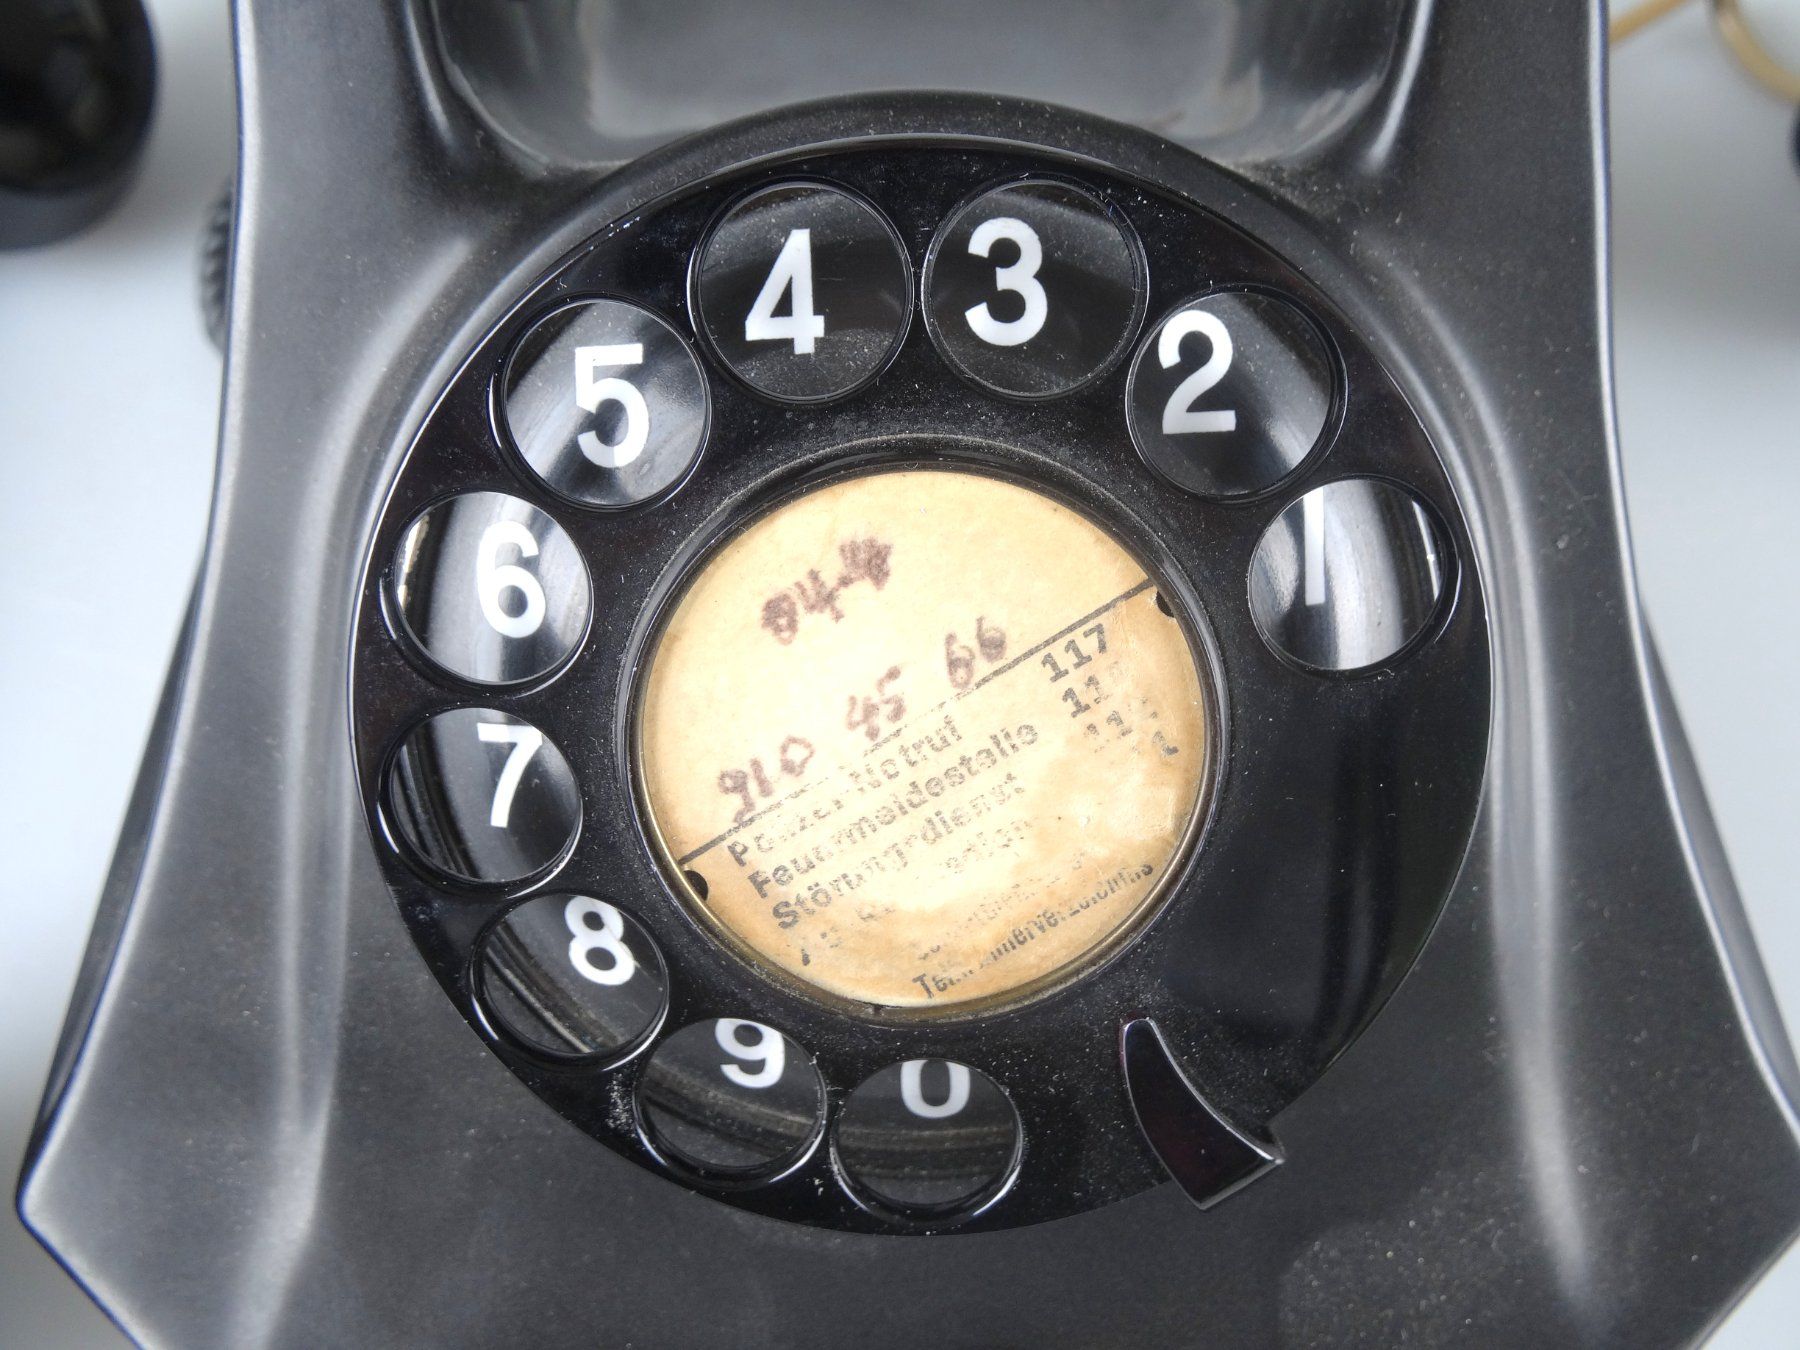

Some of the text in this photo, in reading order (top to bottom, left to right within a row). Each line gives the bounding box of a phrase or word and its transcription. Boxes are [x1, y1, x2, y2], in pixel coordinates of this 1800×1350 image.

[745, 229, 825, 355] 4
[965, 217, 1049, 346] 3
[574, 343, 650, 468] 5
[1157, 309, 1237, 435] 2
[476, 520, 546, 638] 6
[1302, 486, 1326, 606] 1
[942, 615, 1007, 690] 66
[1040, 622, 1110, 684] 117
[477, 722, 543, 828] 7
[564, 895, 635, 986] 8
[714, 1018, 785, 1089] 9
[900, 1059, 971, 1118] 0
